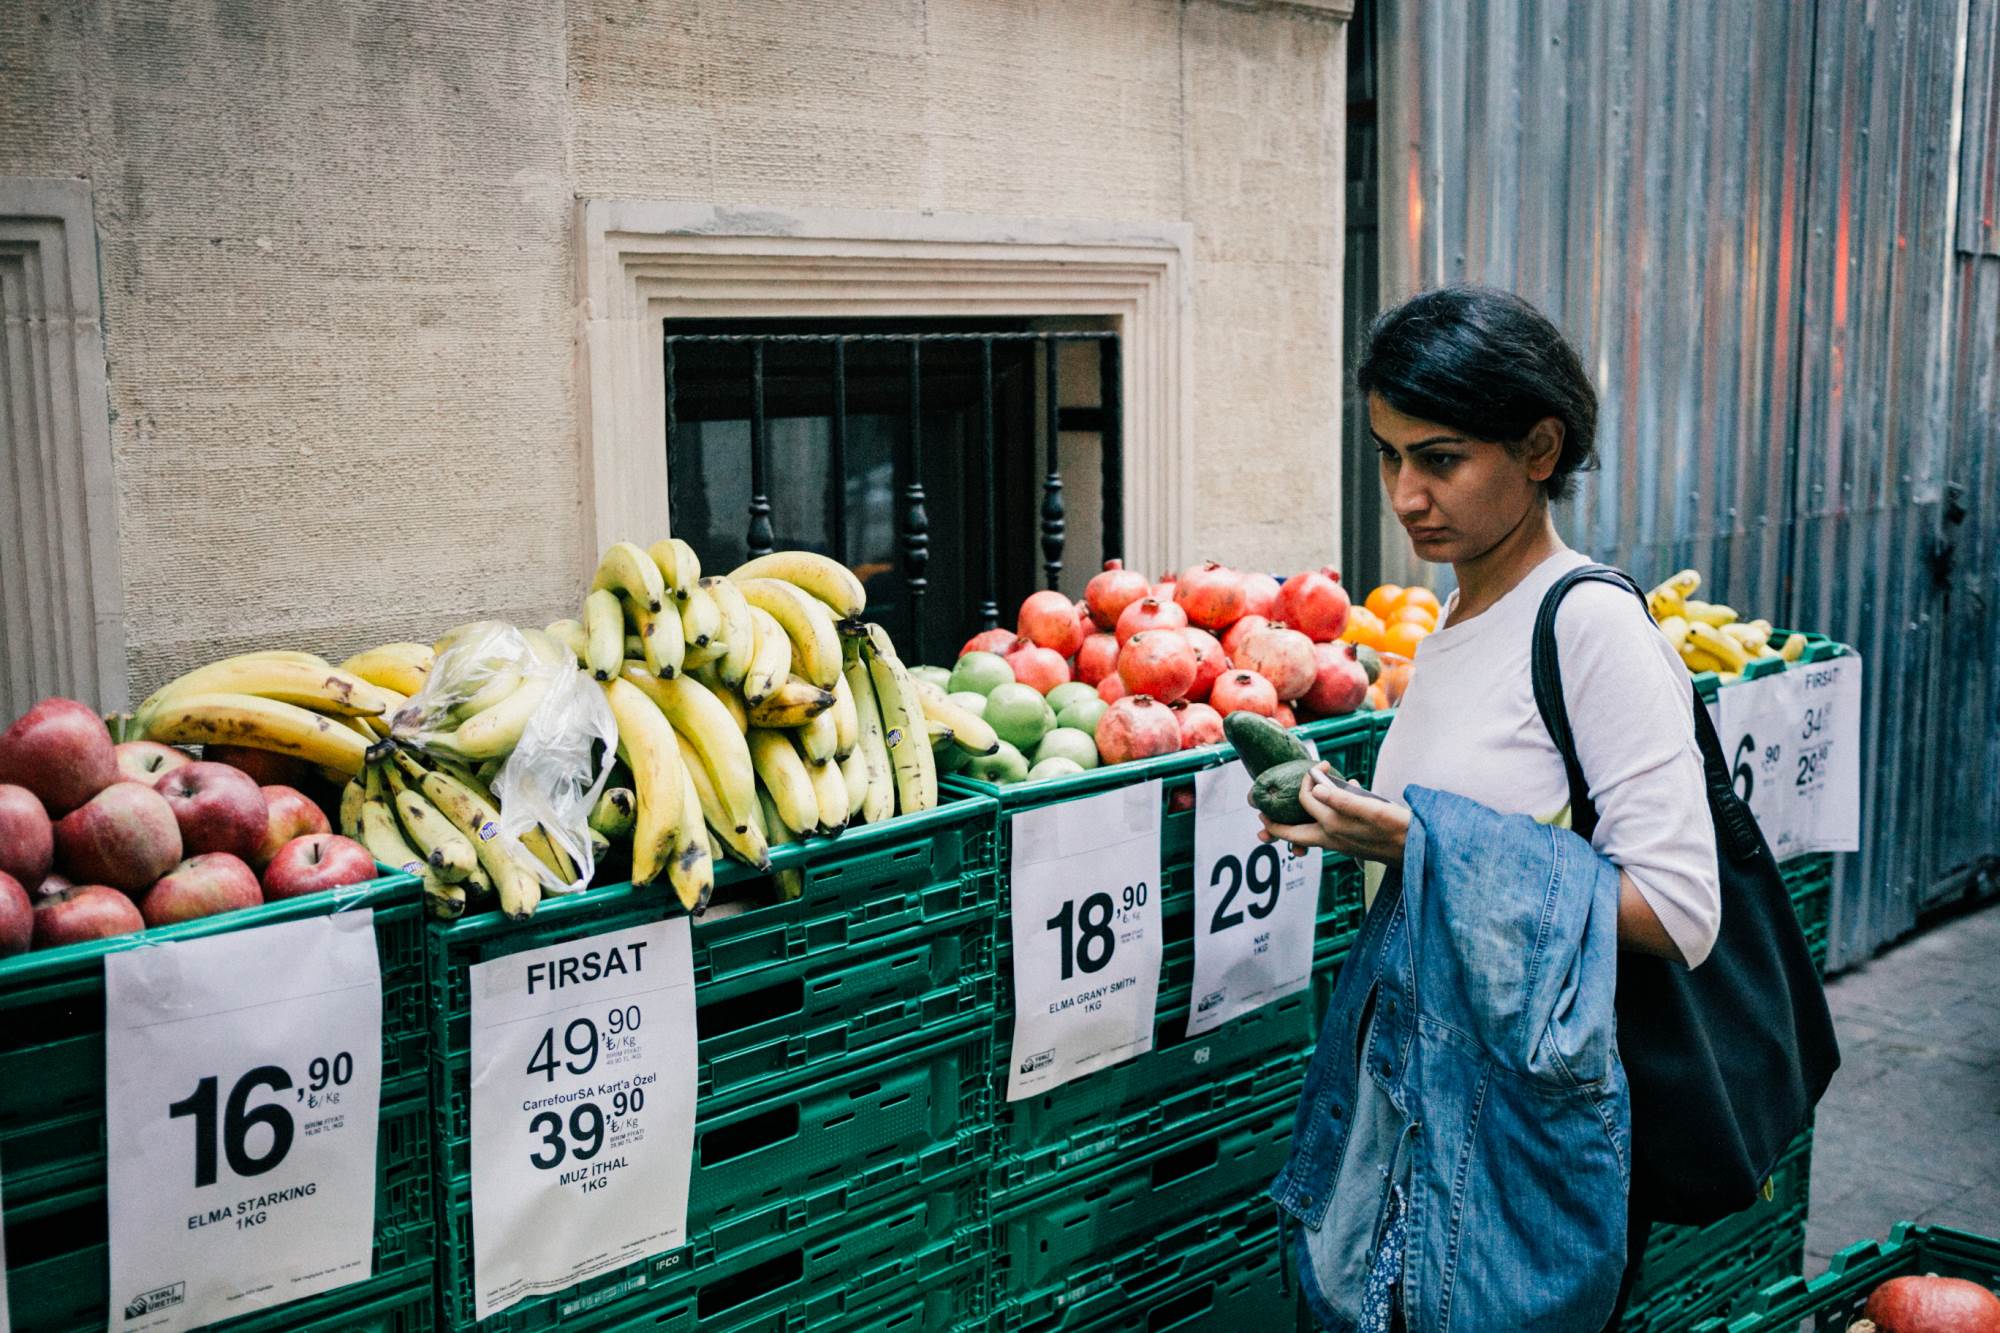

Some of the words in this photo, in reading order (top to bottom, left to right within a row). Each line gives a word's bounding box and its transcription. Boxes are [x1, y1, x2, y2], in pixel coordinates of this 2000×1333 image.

[526, 942, 648, 994] FIRSAT
[1049, 998, 1075, 1014] ELMA
[1077, 986, 1107, 1004] GRANY
[1084, 1000, 1102, 1013] 1KG
[523, 1087, 595, 1111] CarrefourSA
[598, 1079, 630, 1095] Kart'a
[633, 1072, 656, 1088] Özel
[560, 1168, 588, 1186] MUZ
[582, 1177, 608, 1193] 1KG
[188, 1207, 232, 1229] ELMA
[236, 1183, 317, 1214] STARKING
[236, 1211, 267, 1229] 1KG
[656, 1255, 679, 1271] IFCO
